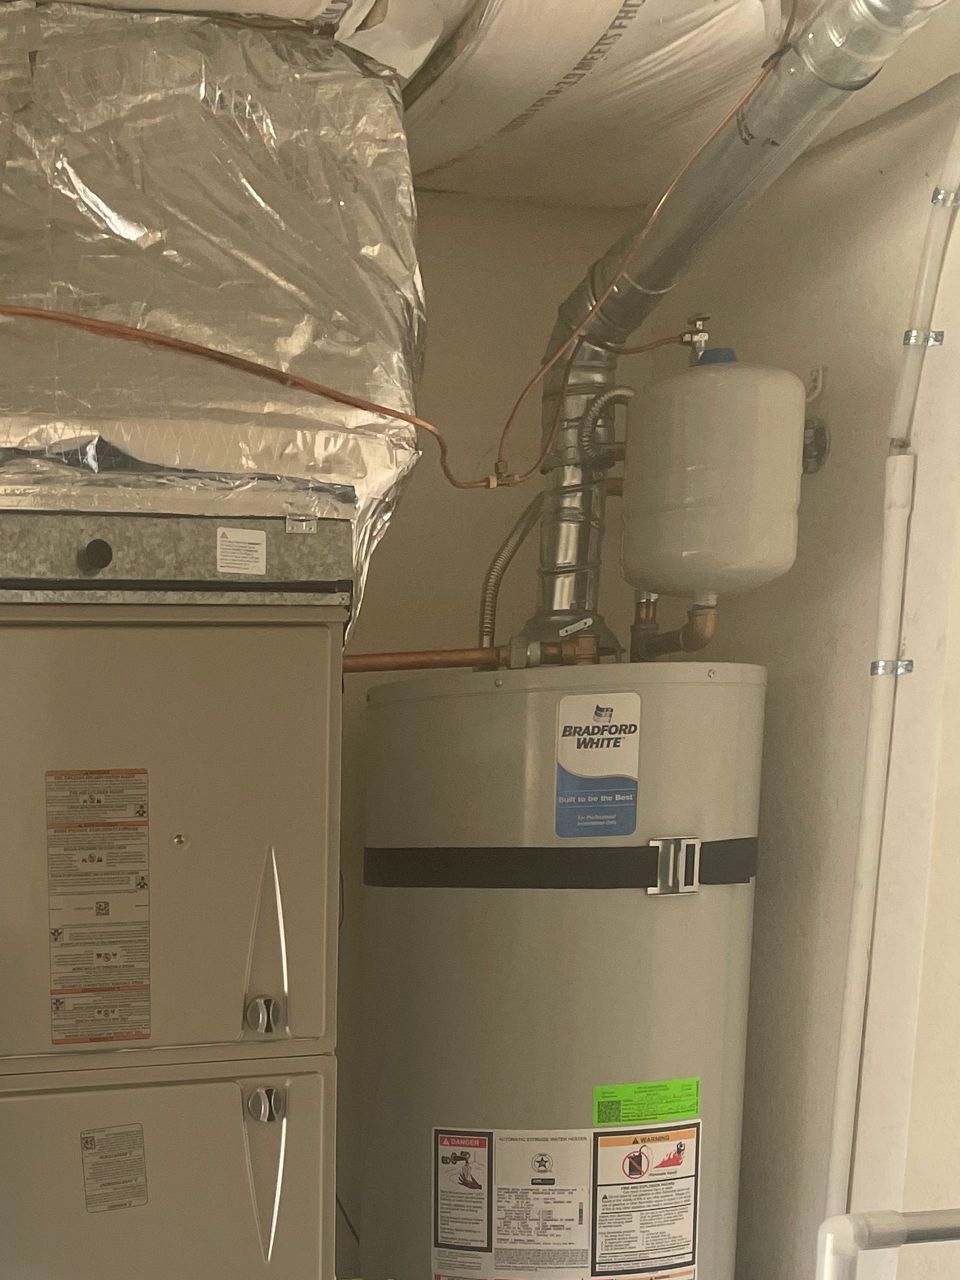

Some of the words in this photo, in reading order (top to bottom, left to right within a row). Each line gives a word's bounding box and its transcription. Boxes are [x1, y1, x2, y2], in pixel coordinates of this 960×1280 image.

[561, 724, 637, 737] BRADFORD
[576, 737, 622, 749] WHITE
[640, 1134, 670, 1143] WARNING
